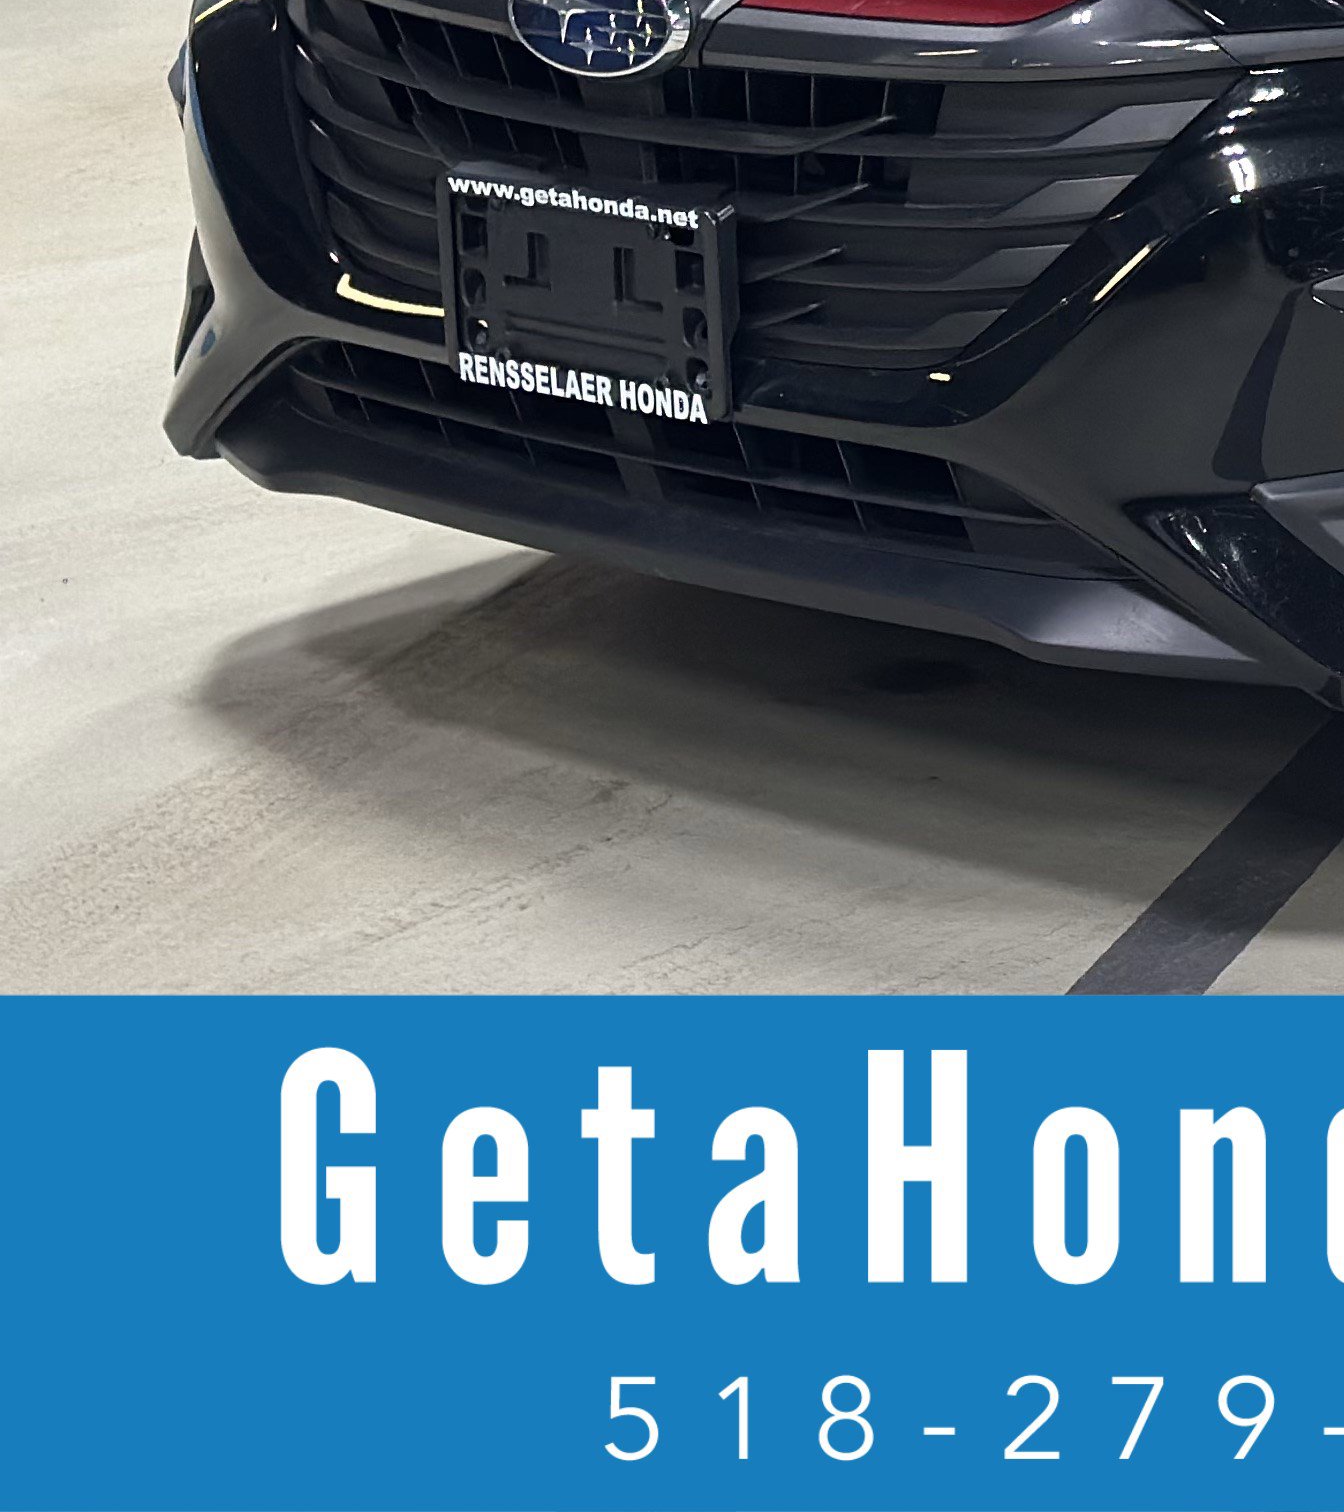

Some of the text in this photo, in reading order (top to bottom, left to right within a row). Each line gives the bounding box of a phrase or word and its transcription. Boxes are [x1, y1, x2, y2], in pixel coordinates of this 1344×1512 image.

[448, 176, 699, 229] www.getahonda.net
[458, 351, 709, 425] RENSSELAER HONDA
